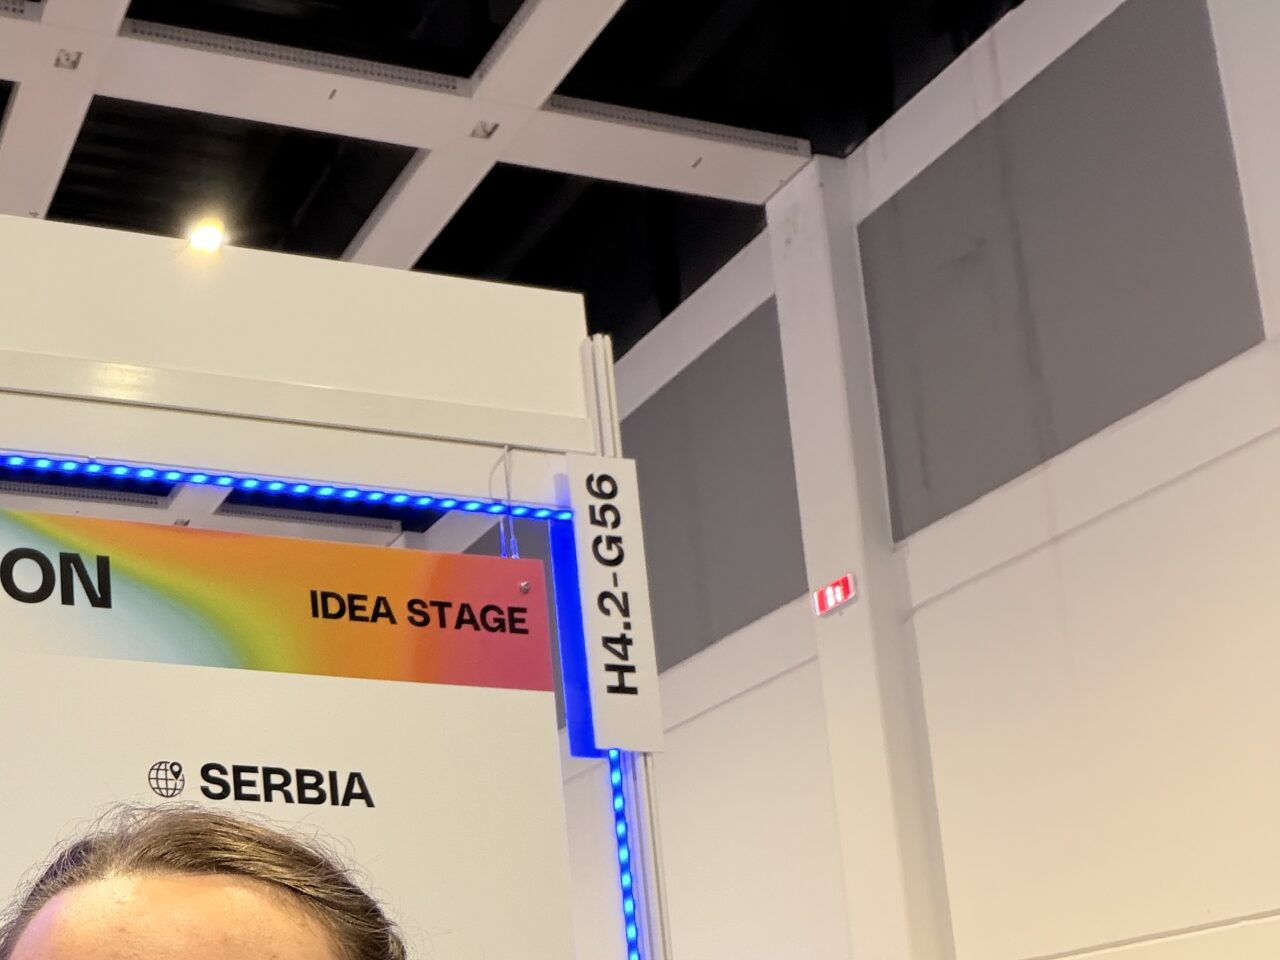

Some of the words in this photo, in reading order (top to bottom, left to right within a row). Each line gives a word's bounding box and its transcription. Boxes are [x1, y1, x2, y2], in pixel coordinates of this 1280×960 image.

[585, 472, 639, 696] H4.2-G56
[310, 589, 397, 625] IDEA
[407, 597, 530, 635] STAGE
[200, 761, 376, 808] SERBIA
